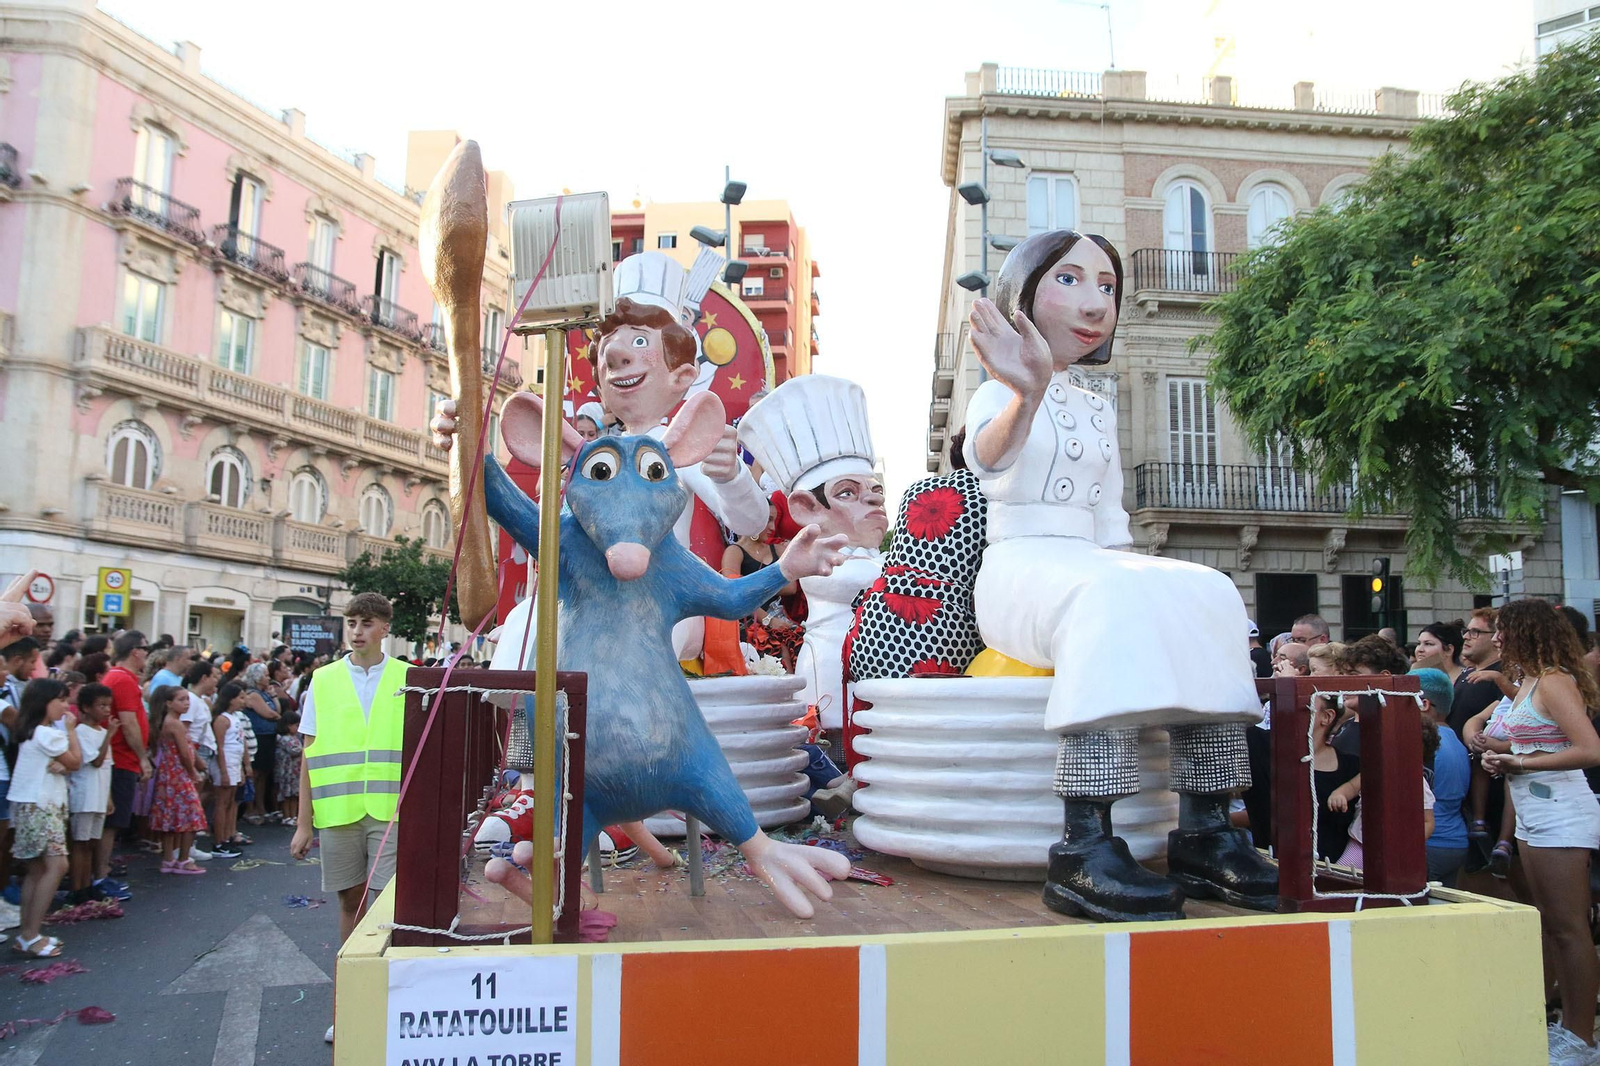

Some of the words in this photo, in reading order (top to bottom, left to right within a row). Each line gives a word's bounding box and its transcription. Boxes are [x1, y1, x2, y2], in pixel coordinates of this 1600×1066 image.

[471, 972, 497, 1000] 11
[399, 1005, 568, 1039] RATATOUILLE
[487, 1052, 562, 1066] TORRE
